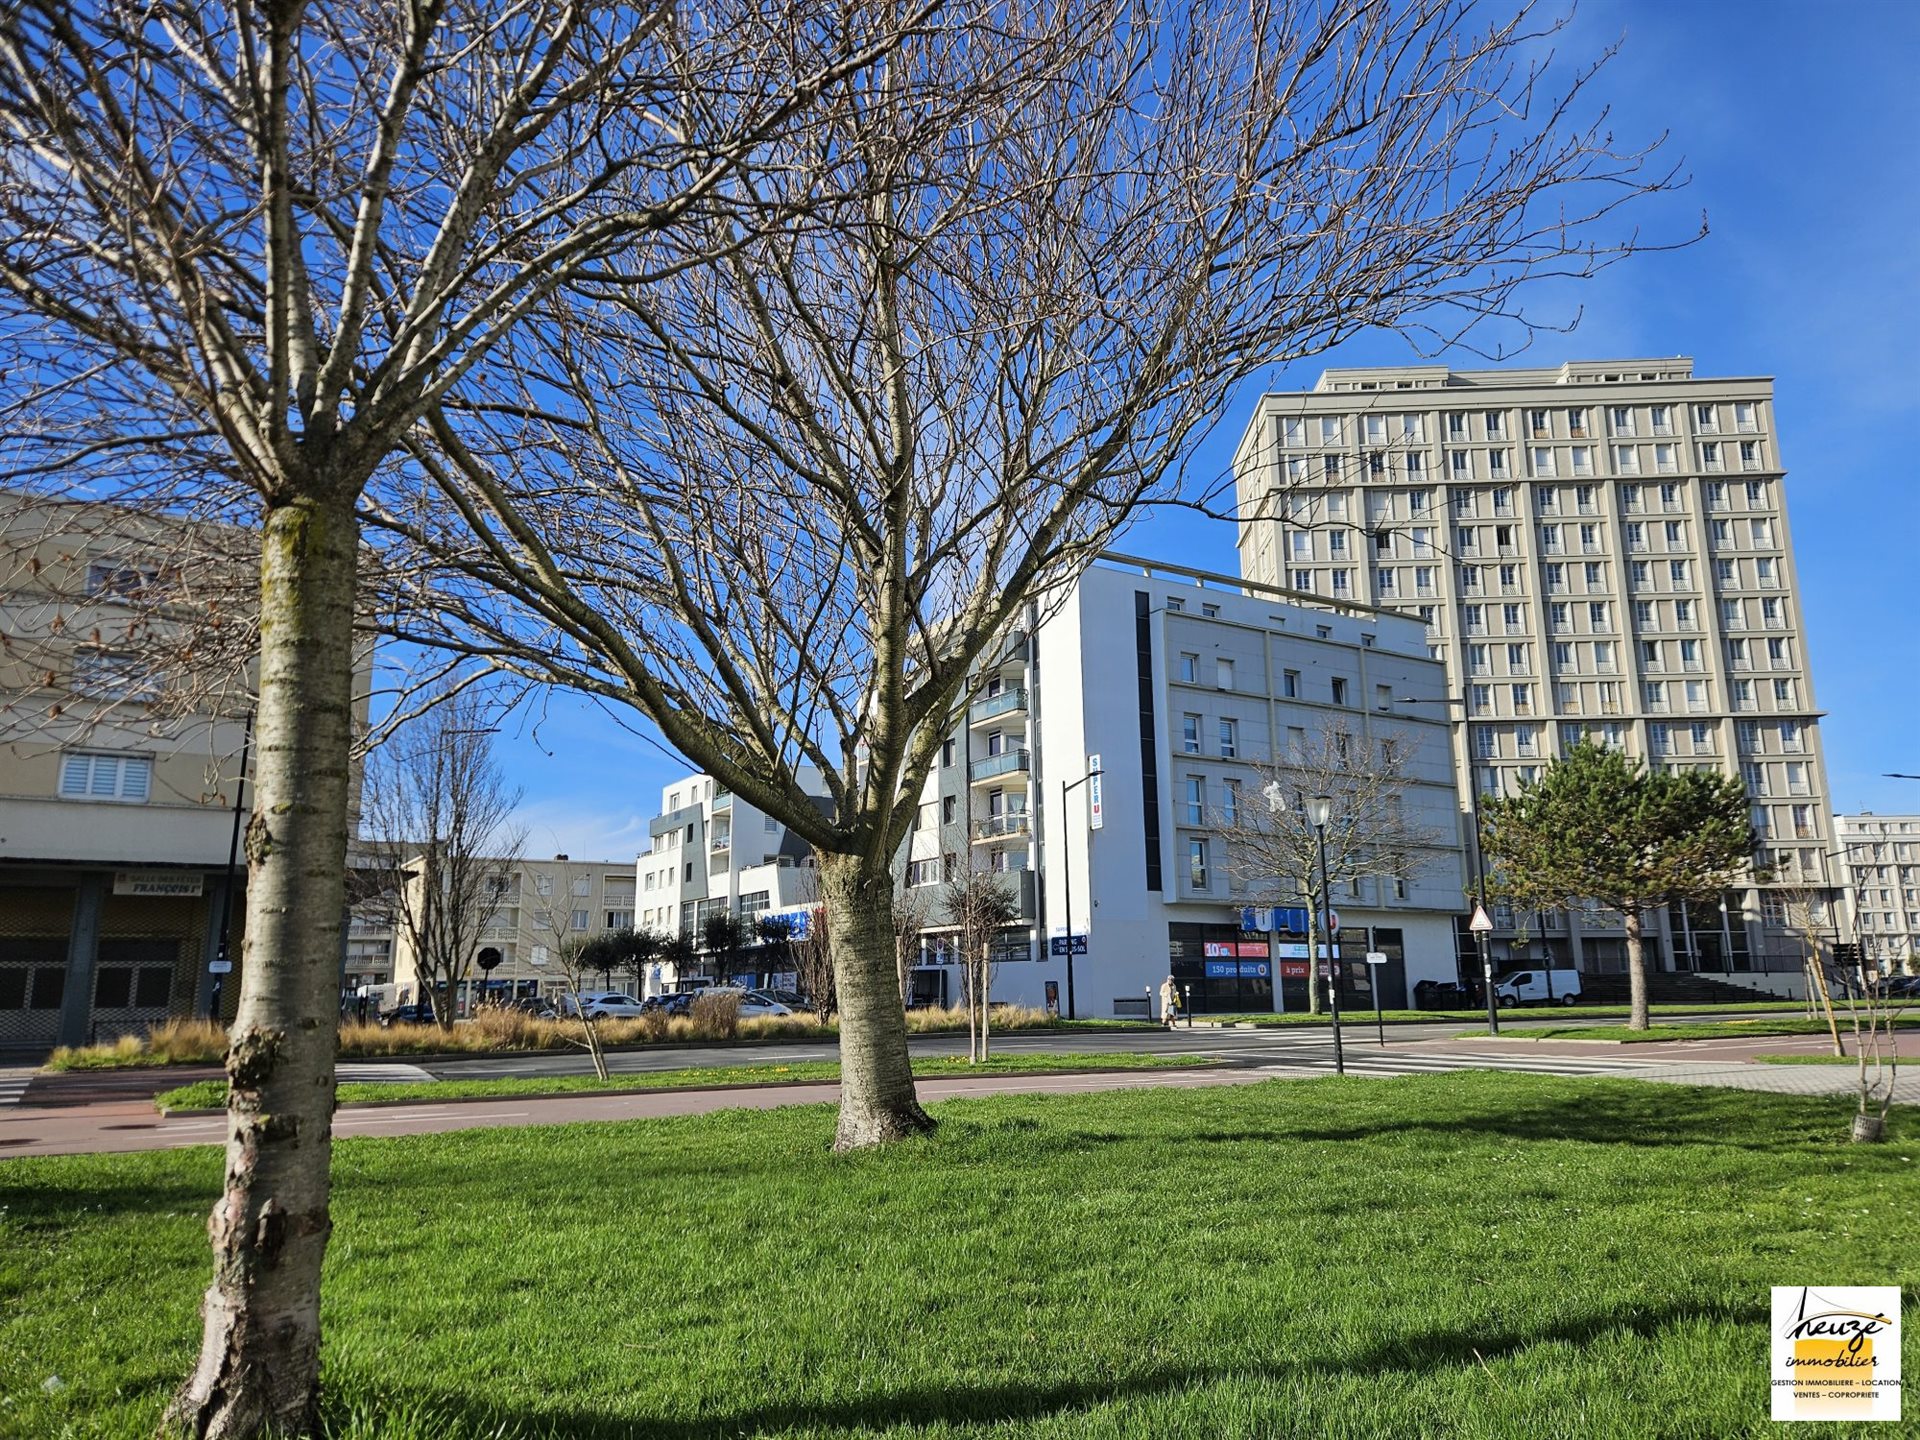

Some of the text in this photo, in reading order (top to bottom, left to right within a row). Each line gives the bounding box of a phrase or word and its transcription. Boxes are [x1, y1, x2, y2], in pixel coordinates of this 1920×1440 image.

[1093, 804, 1100, 814] U
[1212, 965, 1225, 973] 150
[1225, 965, 1256, 975] produits
[1291, 965, 1305, 975] prix
